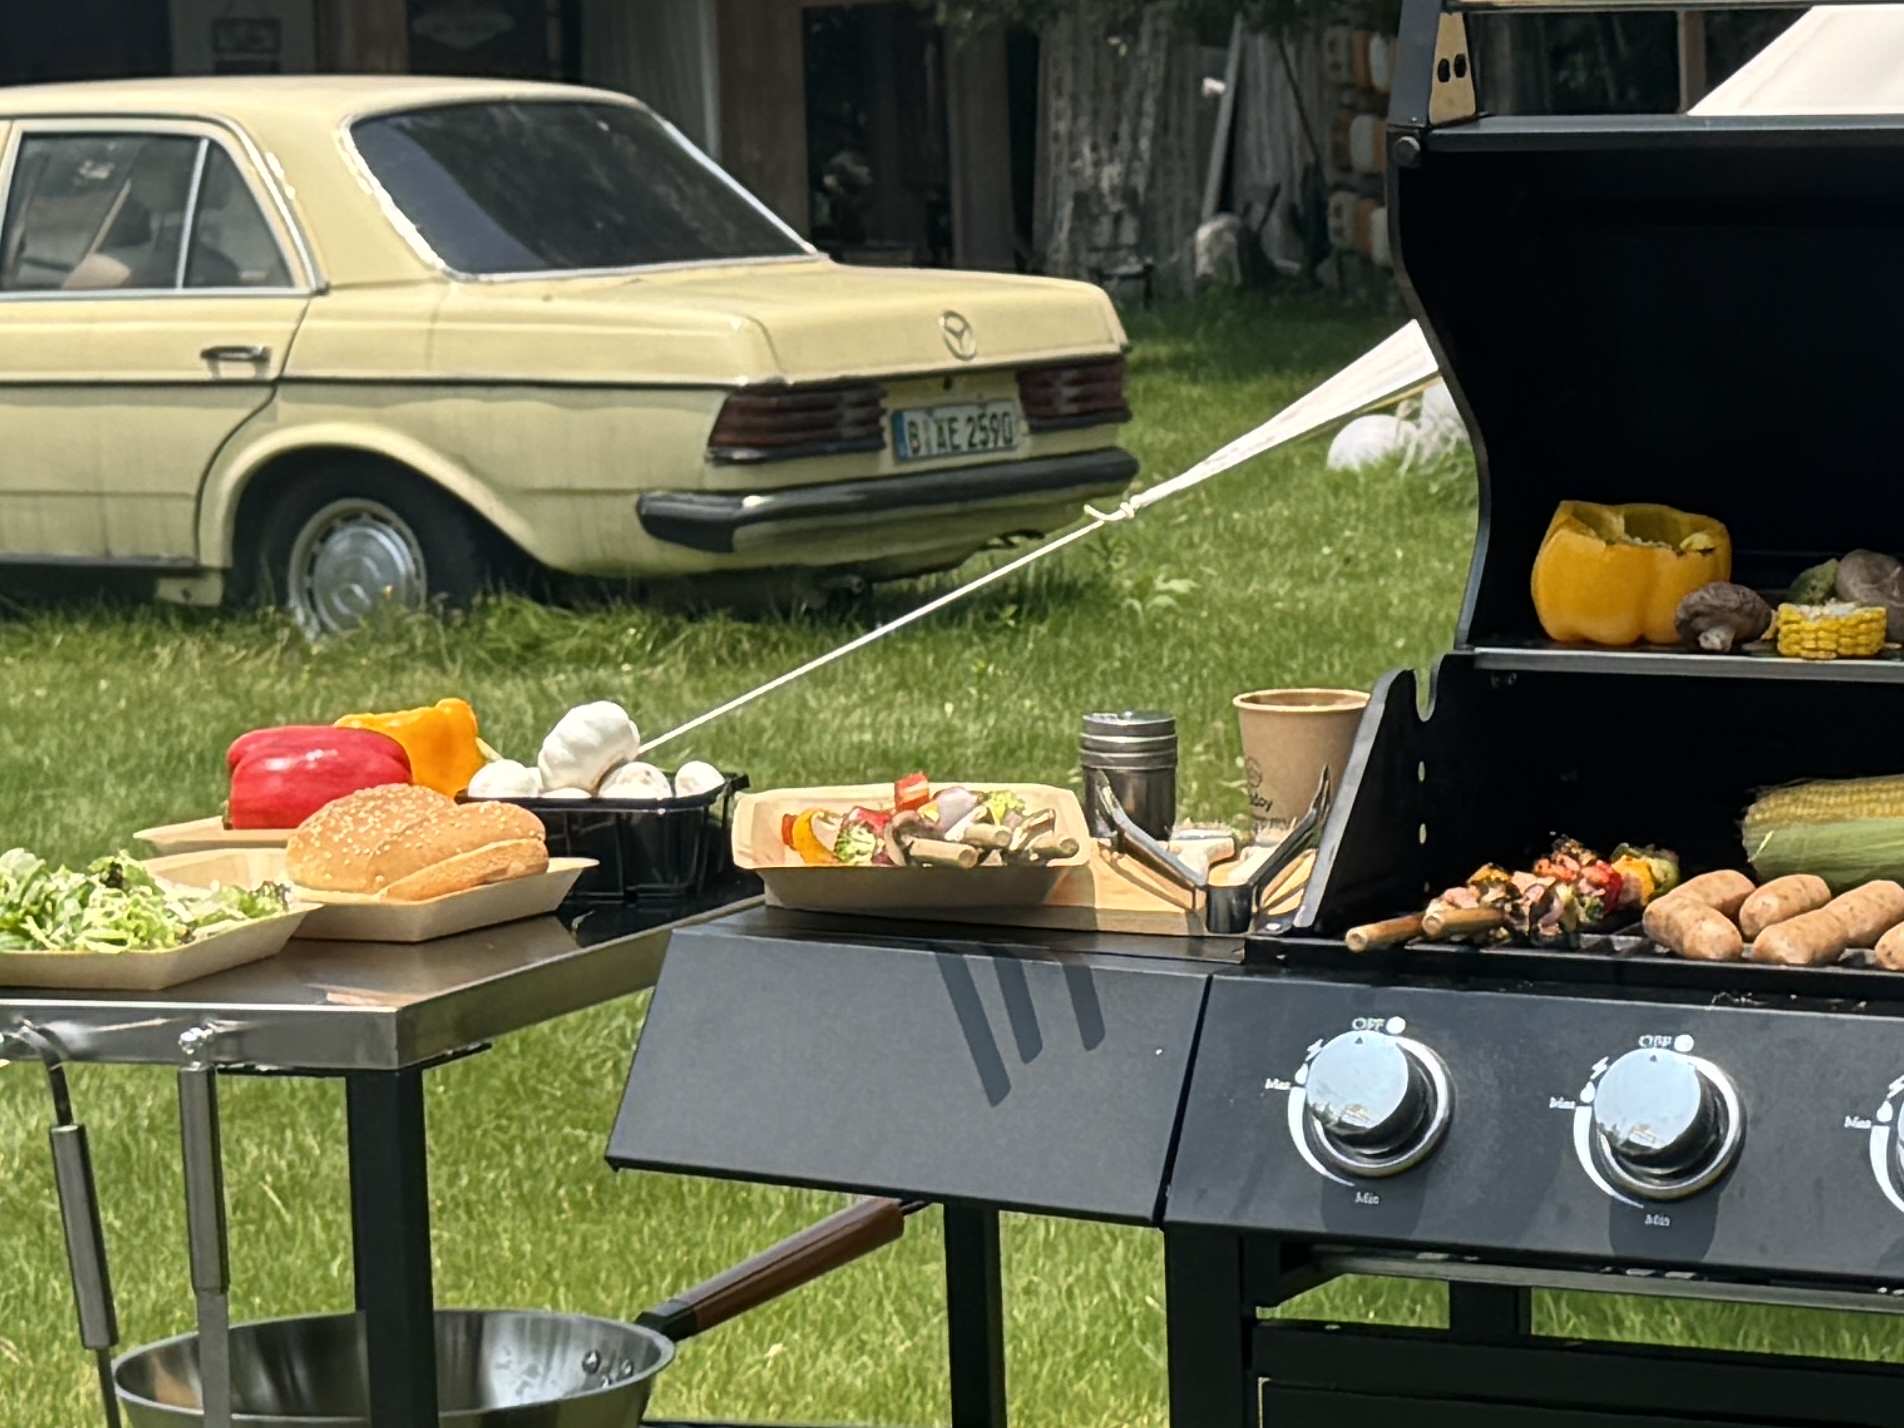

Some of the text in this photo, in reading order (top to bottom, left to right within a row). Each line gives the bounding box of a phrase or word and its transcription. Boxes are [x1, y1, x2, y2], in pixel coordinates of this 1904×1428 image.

[966, 411, 1014, 448] 2590
[1351, 1017, 1385, 1031] OFF
[1638, 1034, 1673, 1048] OFF
